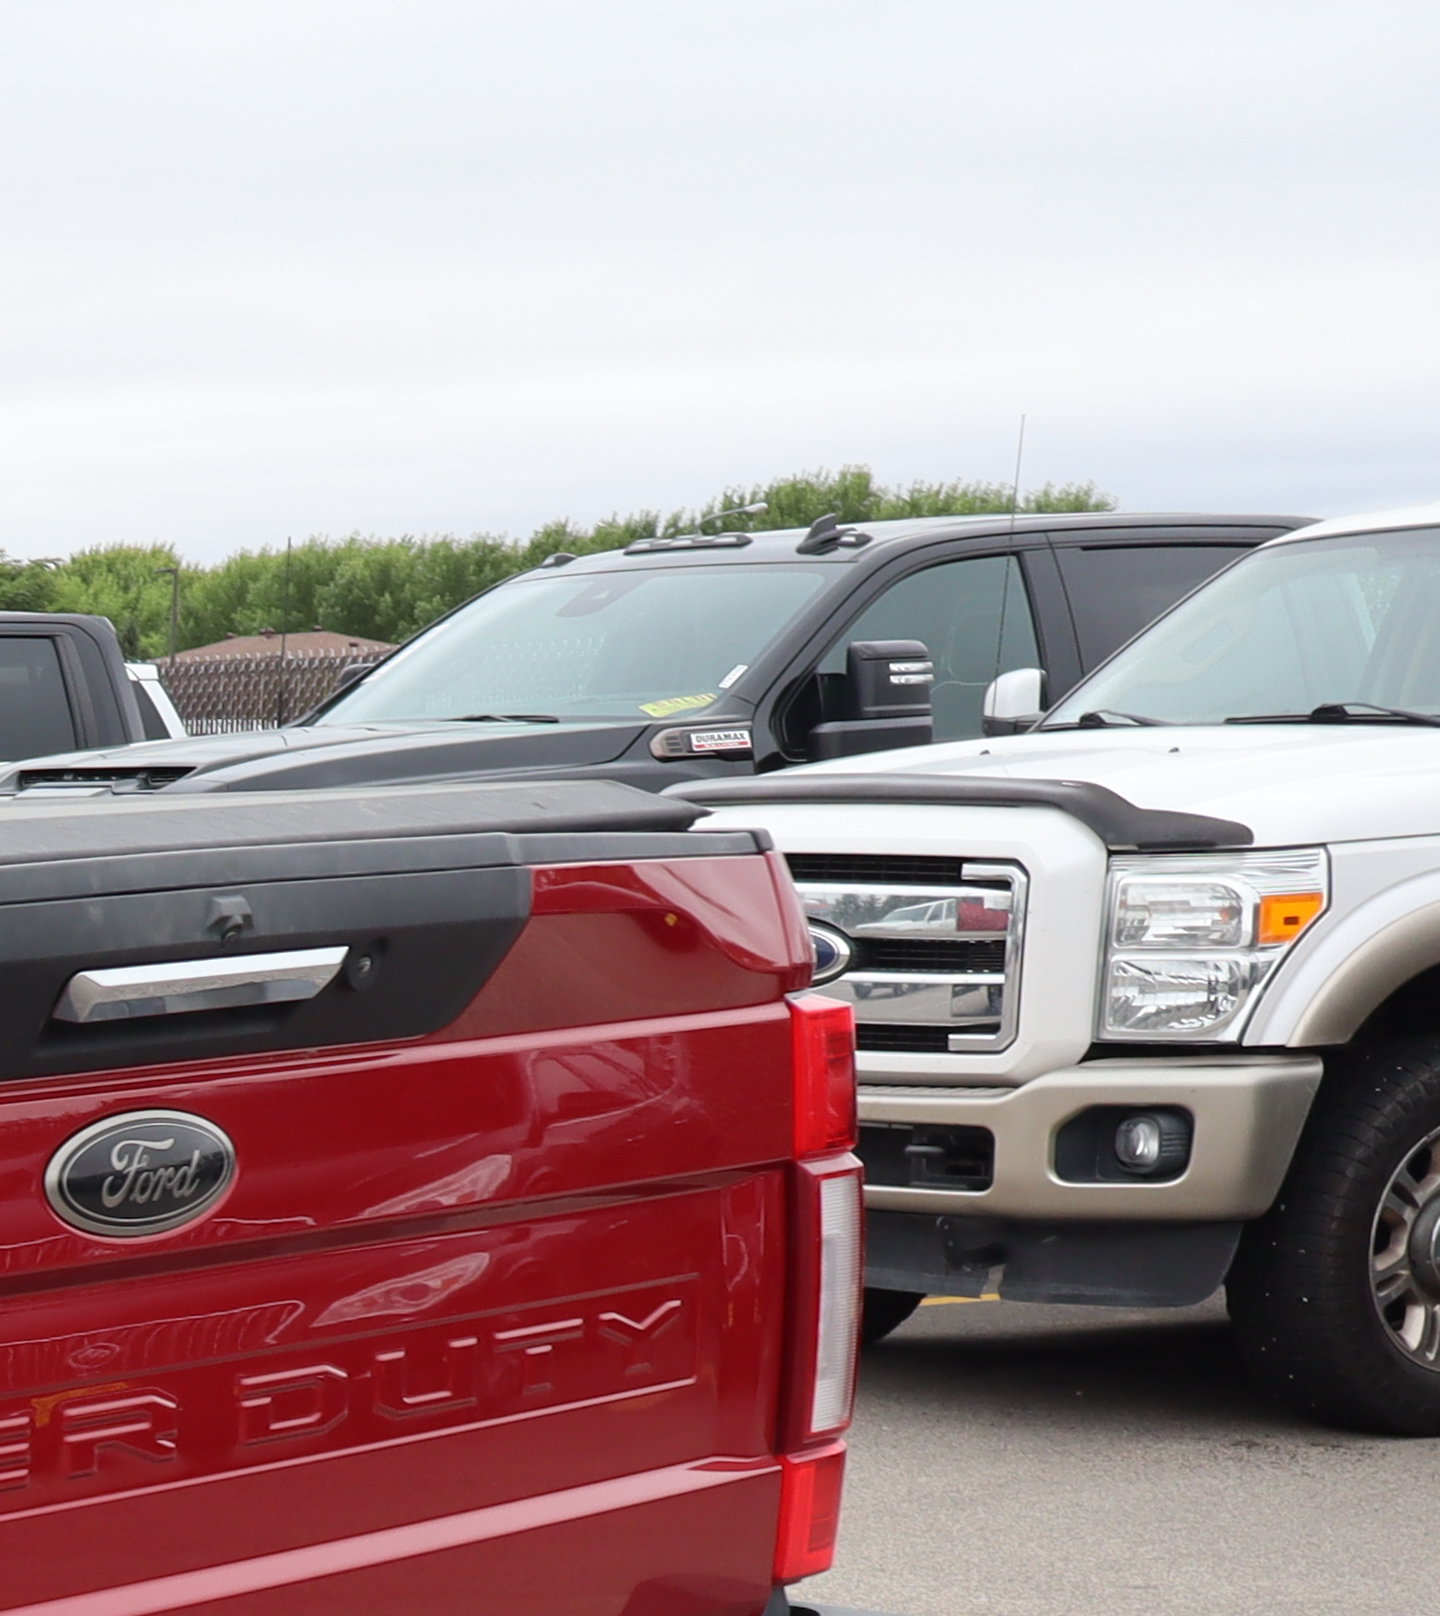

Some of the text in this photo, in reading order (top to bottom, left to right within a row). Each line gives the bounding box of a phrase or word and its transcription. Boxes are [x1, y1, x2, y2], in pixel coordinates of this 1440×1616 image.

[695, 731, 747, 743] DURAMAX
[101, 1137, 201, 1209] Ford
[238, 1299, 683, 1448] DUTY
